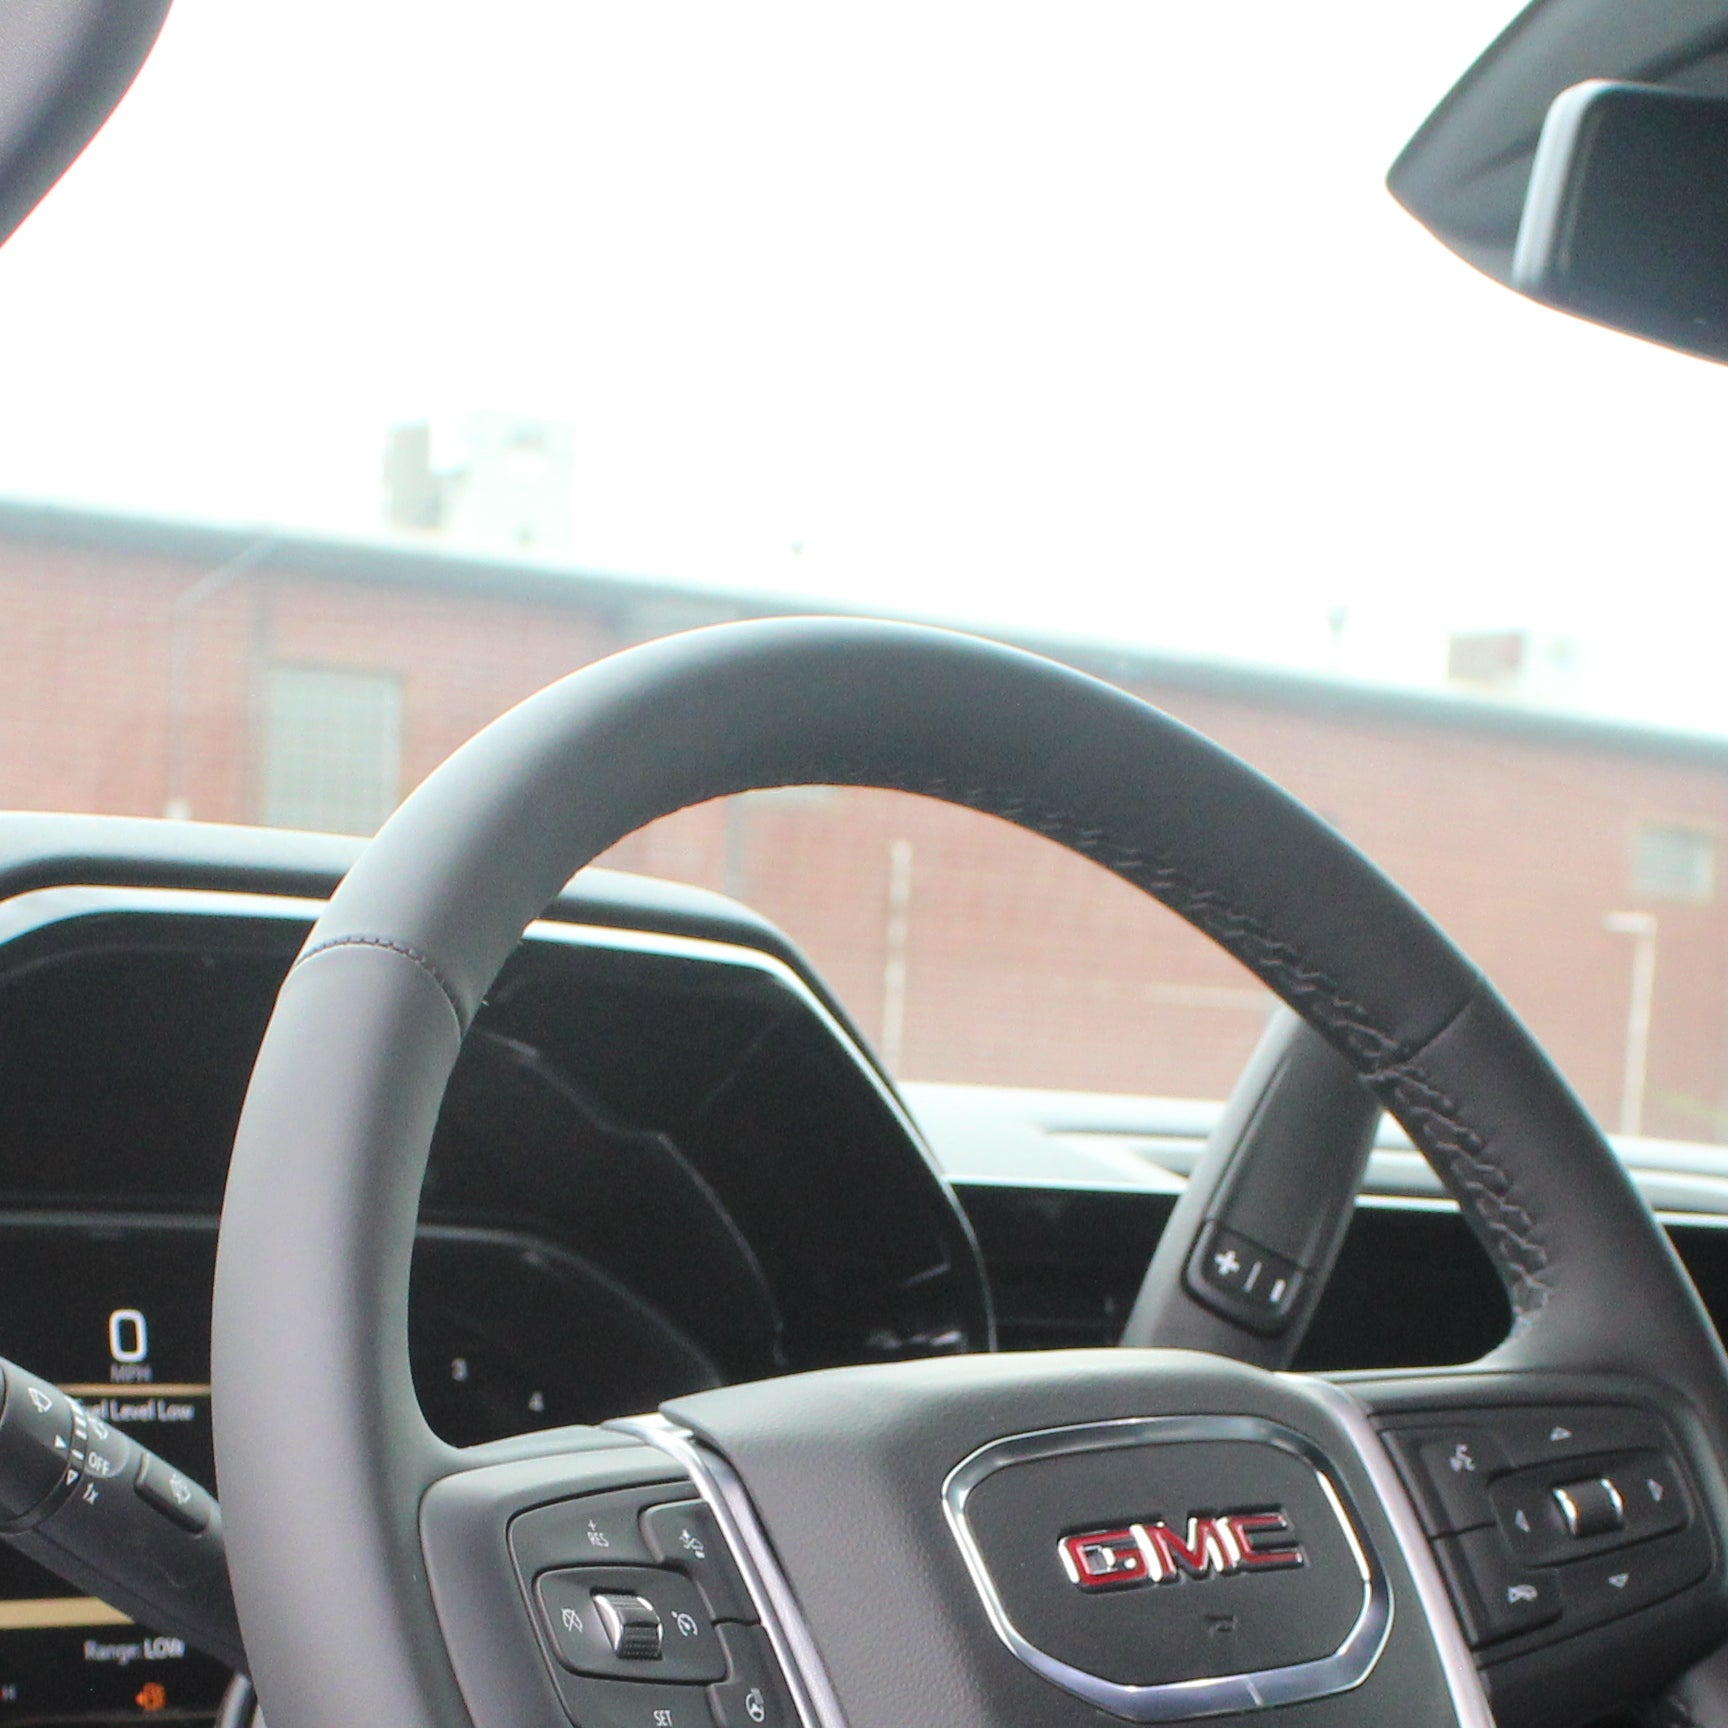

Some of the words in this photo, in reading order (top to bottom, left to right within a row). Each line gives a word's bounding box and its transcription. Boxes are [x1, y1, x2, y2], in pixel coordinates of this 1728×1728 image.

[108, 1308, 148, 1362] 0
[110, 1399, 156, 1421] Level
[157, 1399, 195, 1421] Low
[88, 1452, 110, 1475] OFF
[587, 1531, 609, 1548] RES
[1058, 1512, 1308, 1588] GMC
[143, 1636, 185, 1659] LOW
[653, 1709, 672, 1726] SET
